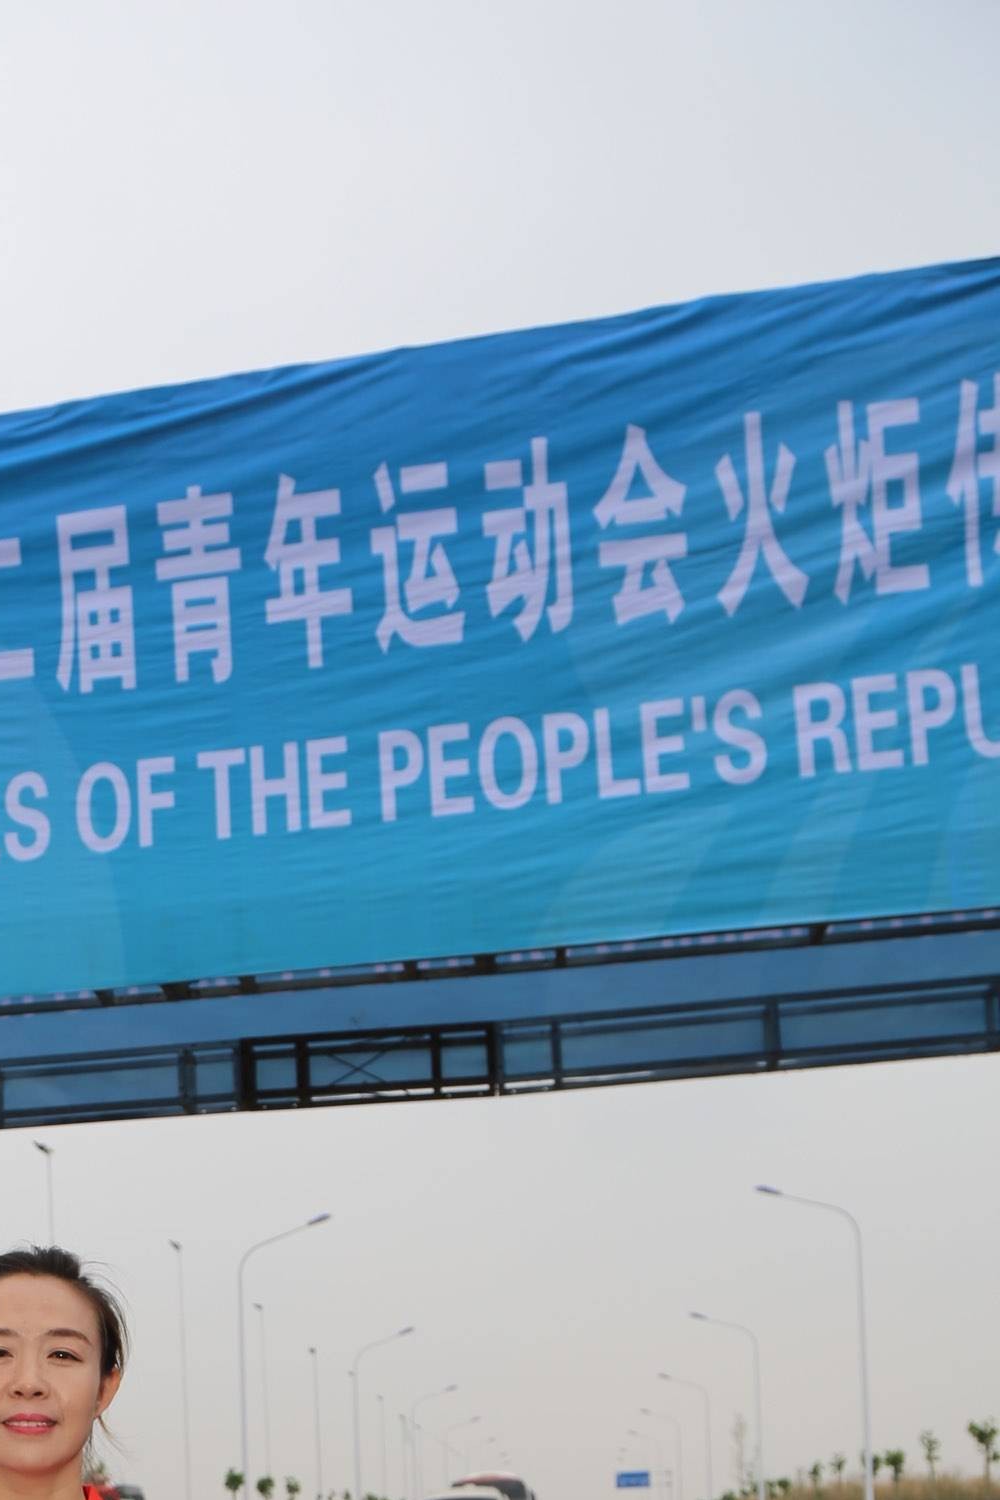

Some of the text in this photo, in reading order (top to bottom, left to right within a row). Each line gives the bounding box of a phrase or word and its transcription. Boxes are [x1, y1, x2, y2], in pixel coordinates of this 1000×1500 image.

[75, 756, 175, 853] OF
[198, 735, 352, 840] THE
[378, 689, 767, 822] PEOPLE'S
